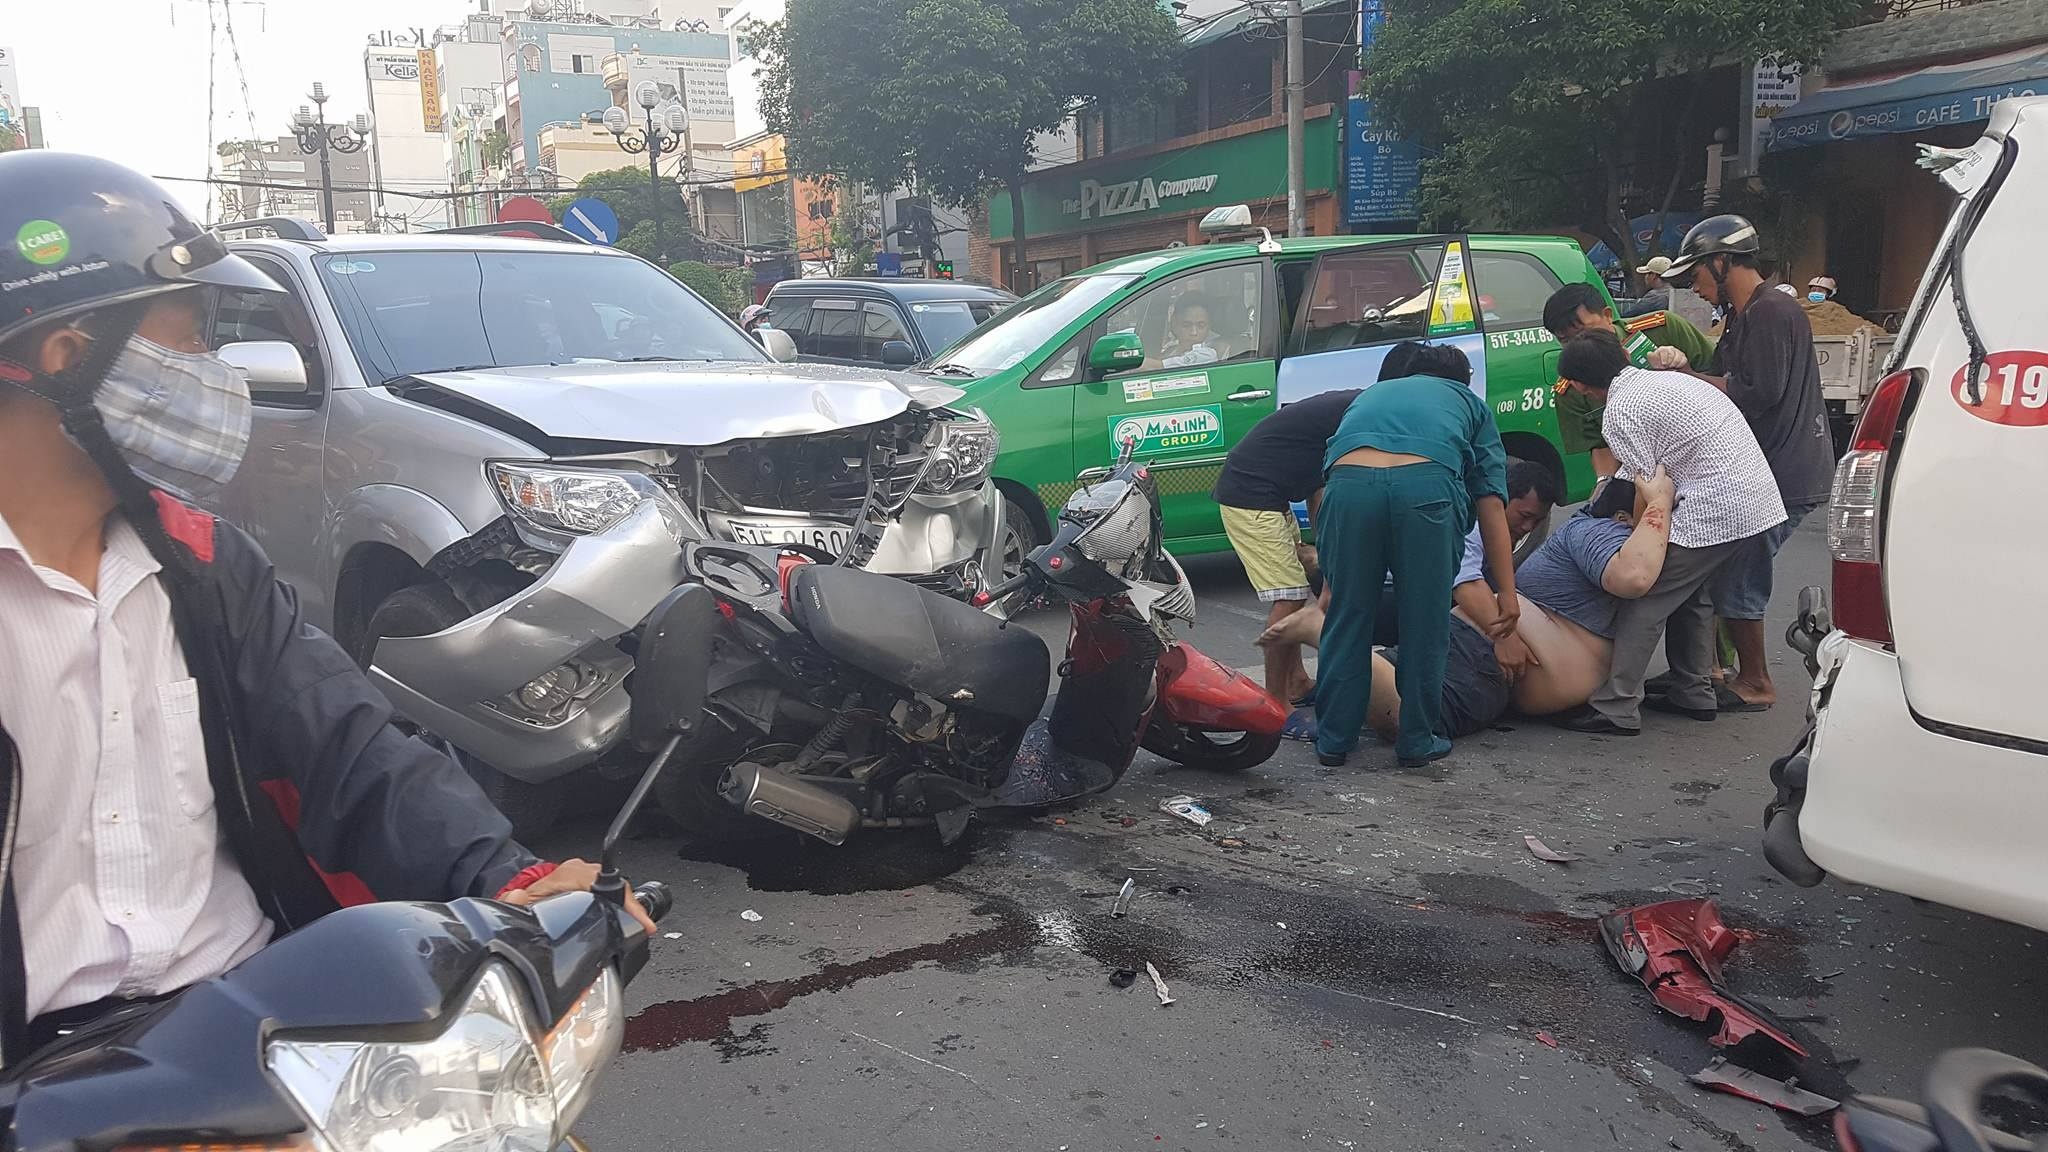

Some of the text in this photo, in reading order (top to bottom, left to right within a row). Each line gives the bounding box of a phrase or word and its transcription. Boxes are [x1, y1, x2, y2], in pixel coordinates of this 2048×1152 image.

[1853, 108, 1901, 131] pepsi
[1915, 101, 1961, 126] CAFÉ
[1079, 177, 1160, 220] PIZZA
[1960, 360, 2048, 409] 819
[1496, 399, 1517, 415] (08)
[1521, 387, 1544, 411] 38
[1161, 433, 1208, 447] GROUP
[810, 585, 821, 610] HONDA
